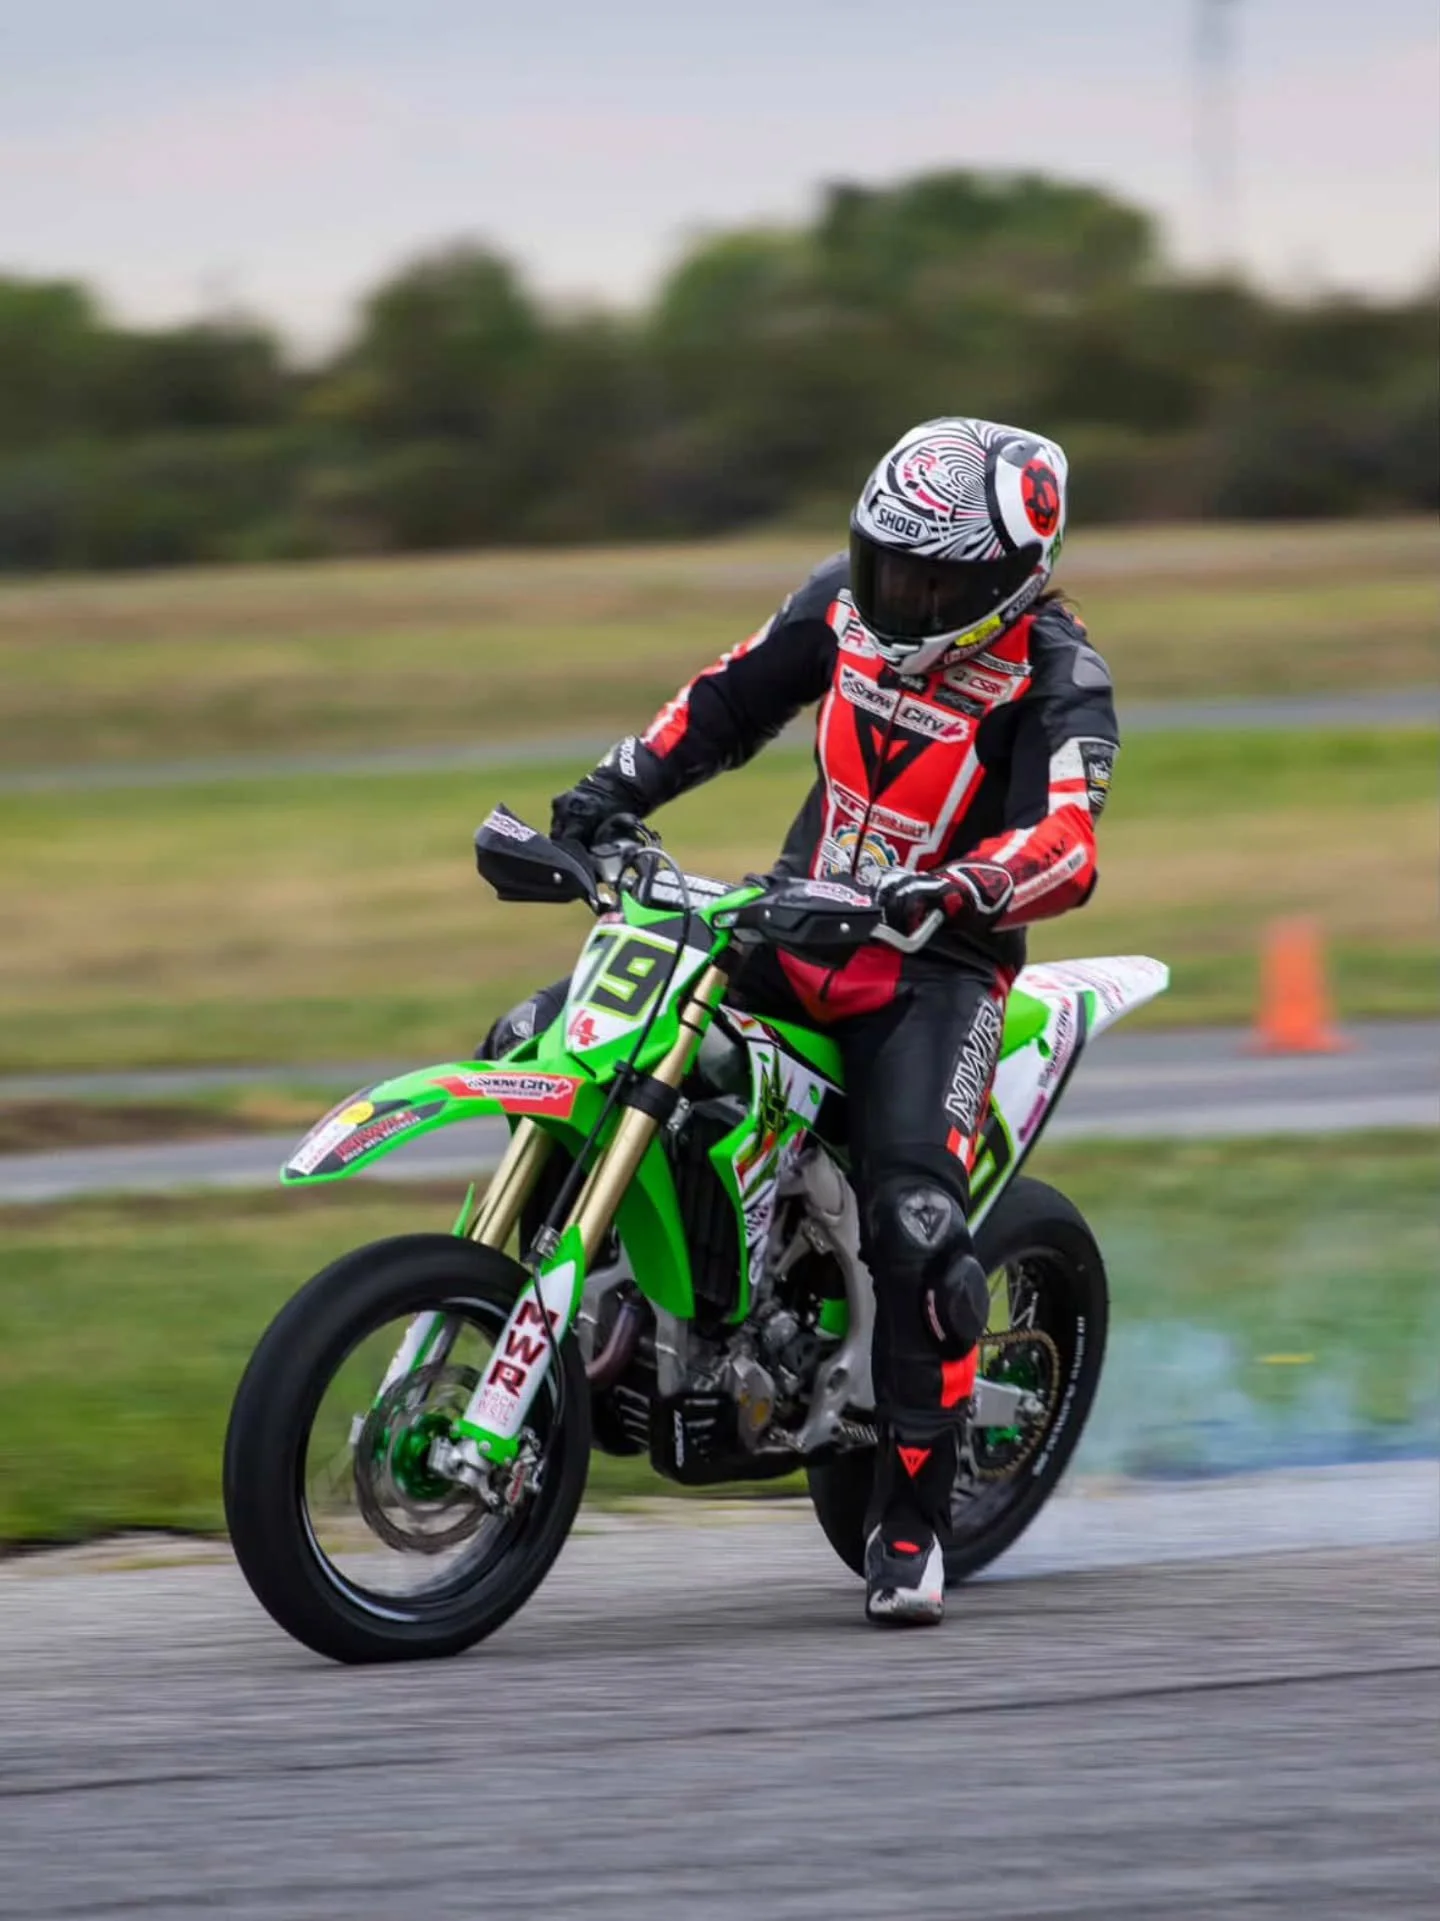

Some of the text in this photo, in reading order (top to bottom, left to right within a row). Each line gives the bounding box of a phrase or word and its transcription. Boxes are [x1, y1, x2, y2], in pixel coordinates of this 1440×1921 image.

[877, 507, 922, 538] SHOEI
[902, 706, 945, 731] City
[944, 999, 1002, 1137] MWR
